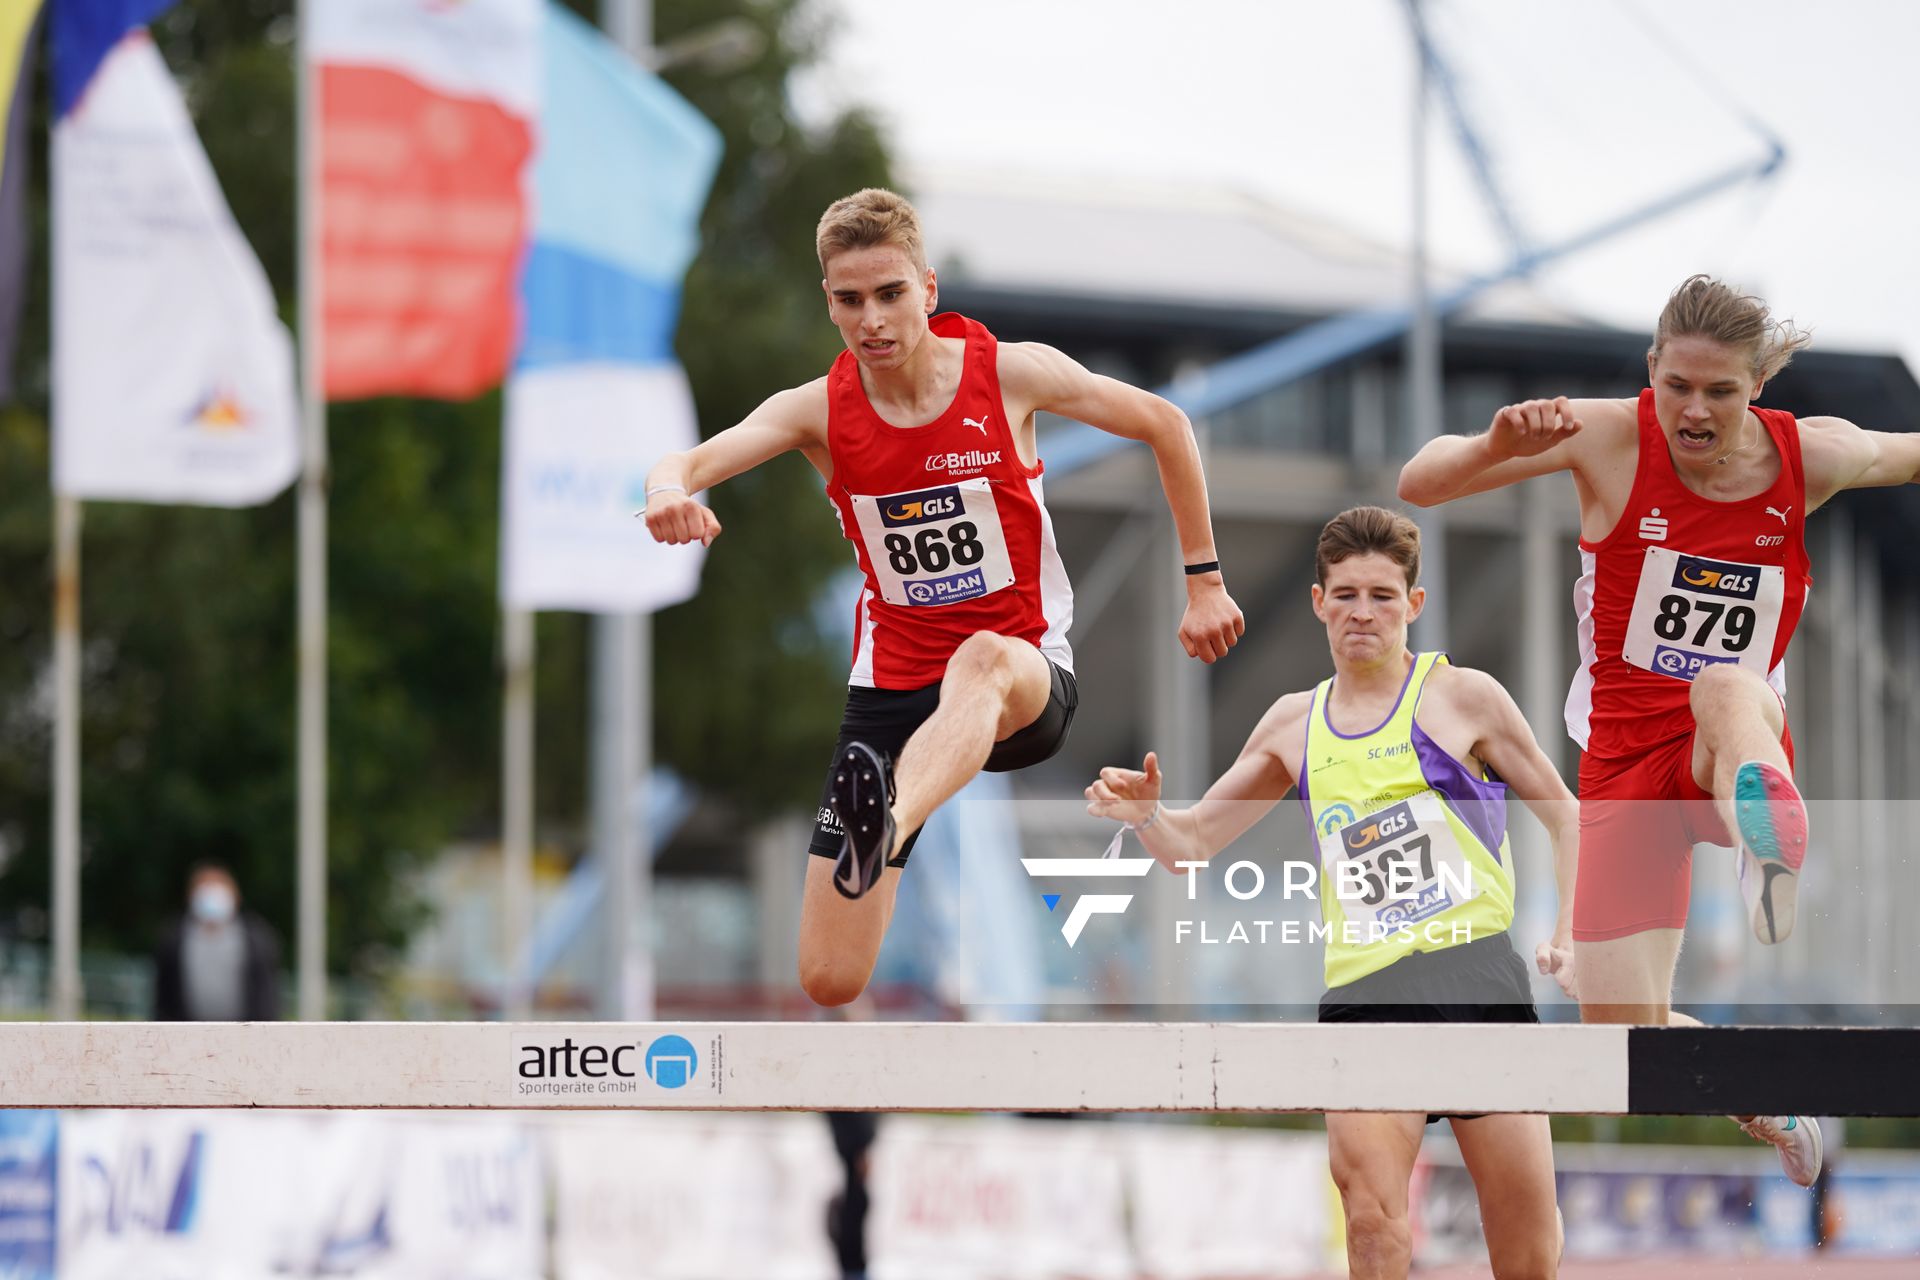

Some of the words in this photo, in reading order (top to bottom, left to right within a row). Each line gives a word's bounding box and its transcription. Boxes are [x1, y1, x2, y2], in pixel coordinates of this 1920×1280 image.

[947, 450, 1002, 468] Brillux
[948, 467, 984, 476] Münster
[923, 496, 955, 516] GLS
[884, 521, 984, 575] 868
[935, 574, 982, 595] PLAN
[1718, 573, 1753, 593] GLS
[938, 587, 984, 601] INTERNATIONAL
[1654, 594, 1756, 652] 879
[1368, 747, 1382, 760] SC
[1379, 812, 1409, 838] GLS
[1349, 833, 1435, 906] 587
[519, 1038, 635, 1078] artec
[519, 1081, 595, 1096] Sportgeräte
[598, 1081, 636, 1093] GmbH
